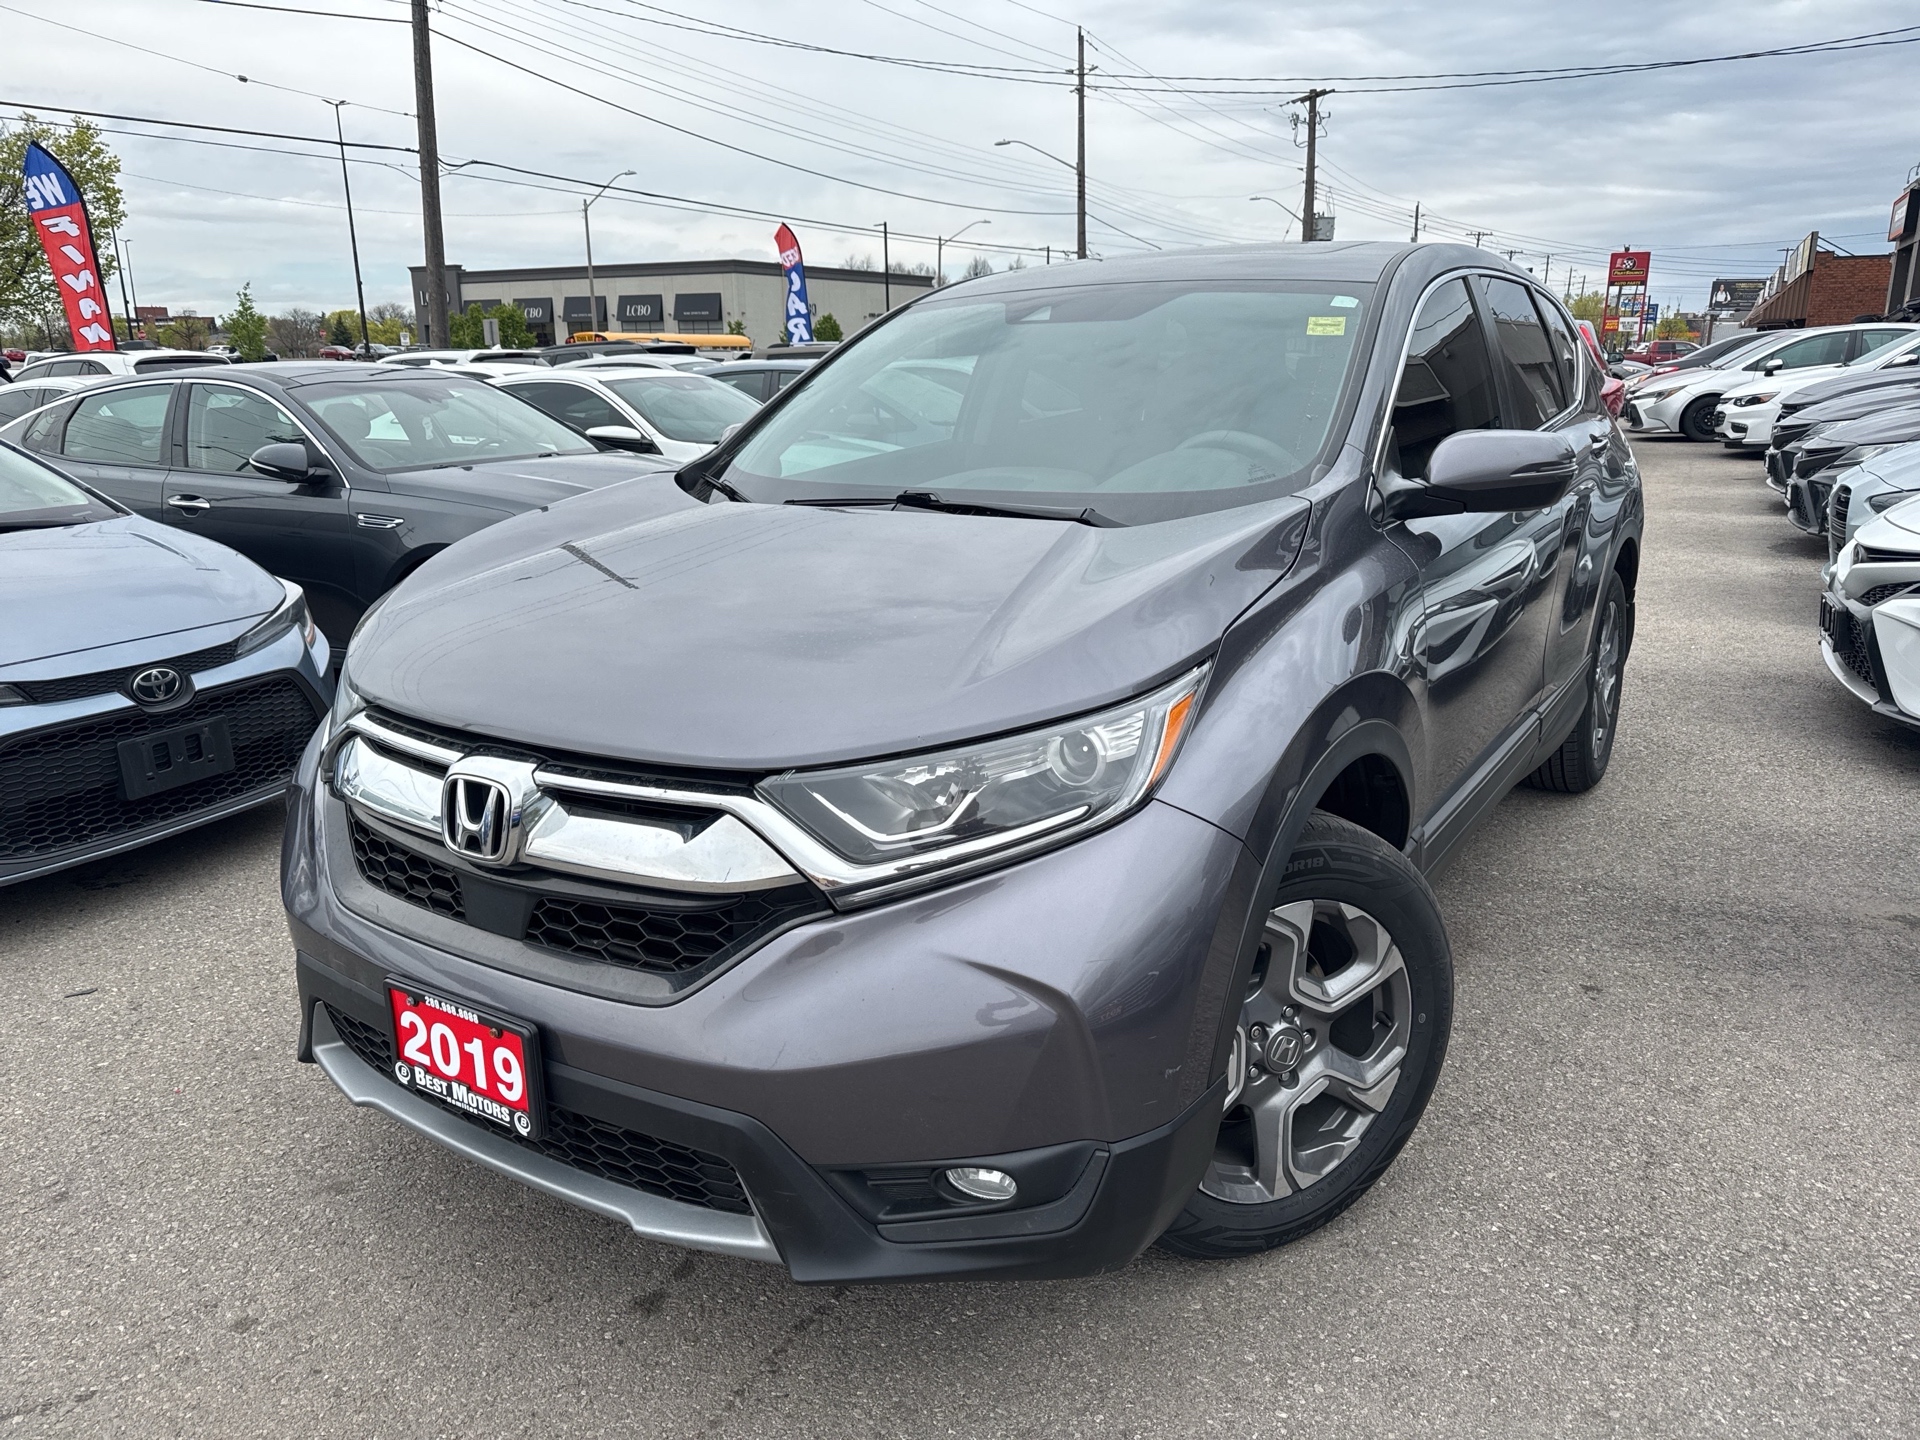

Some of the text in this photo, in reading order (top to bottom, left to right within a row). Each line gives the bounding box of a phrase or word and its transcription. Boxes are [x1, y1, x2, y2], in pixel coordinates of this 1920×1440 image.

[524, 307, 543, 319] CBO
[626, 304, 651, 317] LCBO
[400, 1010, 523, 1102] 2019
[414, 1066, 511, 1122] BEST MOTORS
